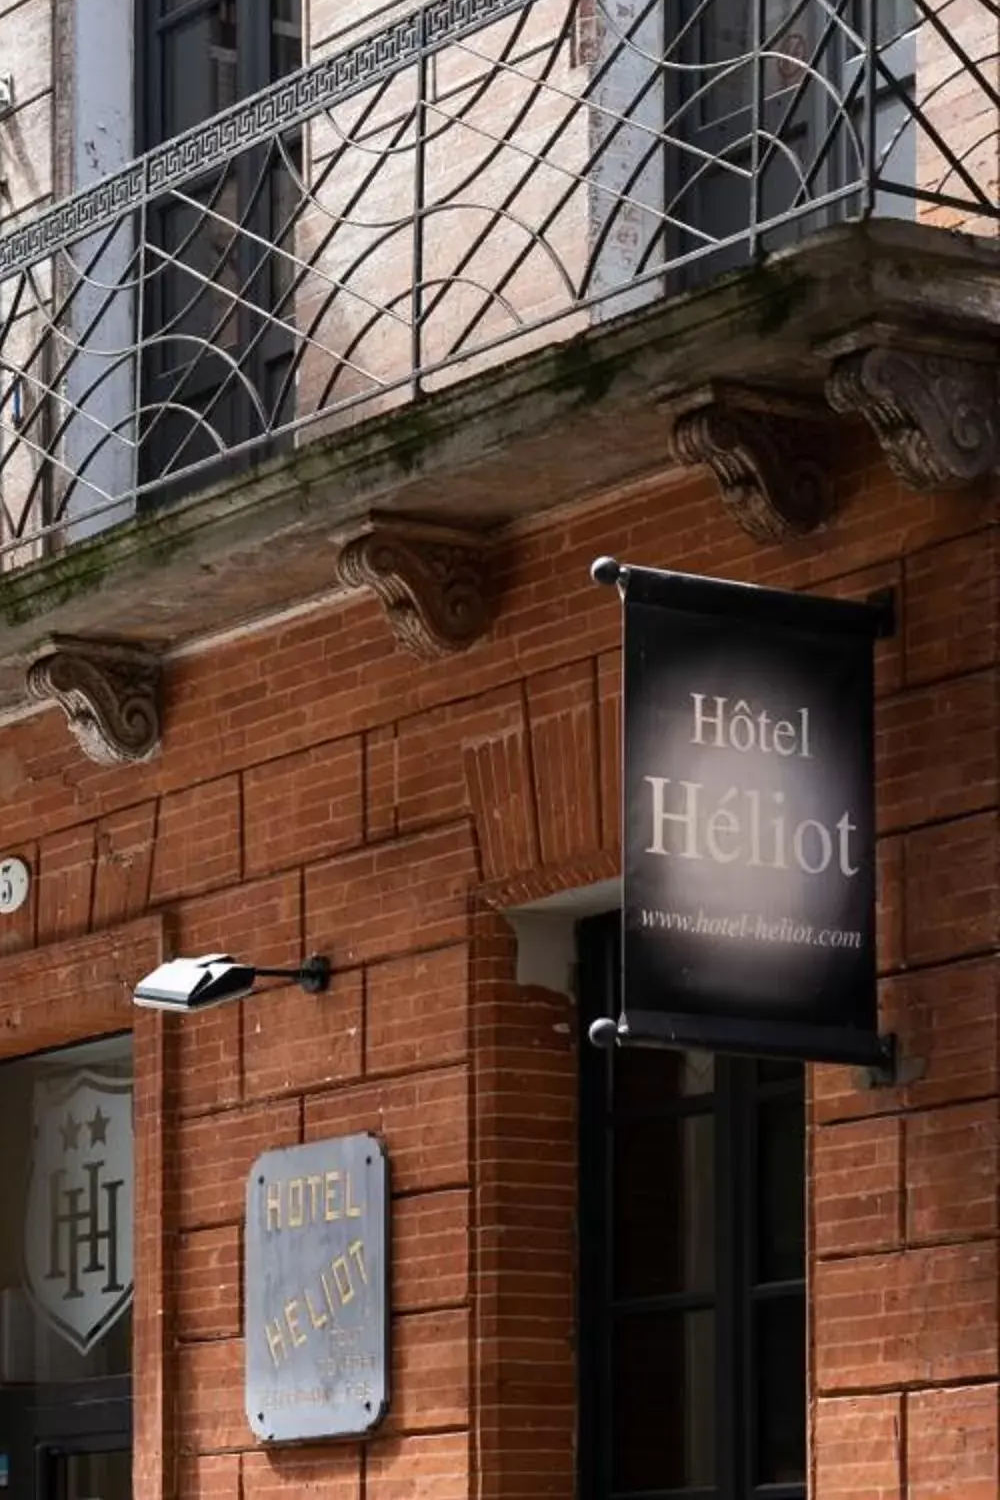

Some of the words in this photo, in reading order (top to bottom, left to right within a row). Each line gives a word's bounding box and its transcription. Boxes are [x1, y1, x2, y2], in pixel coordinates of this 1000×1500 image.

[690, 691, 814, 758] Hôtel
[644, 775, 860, 878] Héliot
[265, 1170, 361, 1232] HOTEL
[265, 1239, 369, 1370] HELIOT
